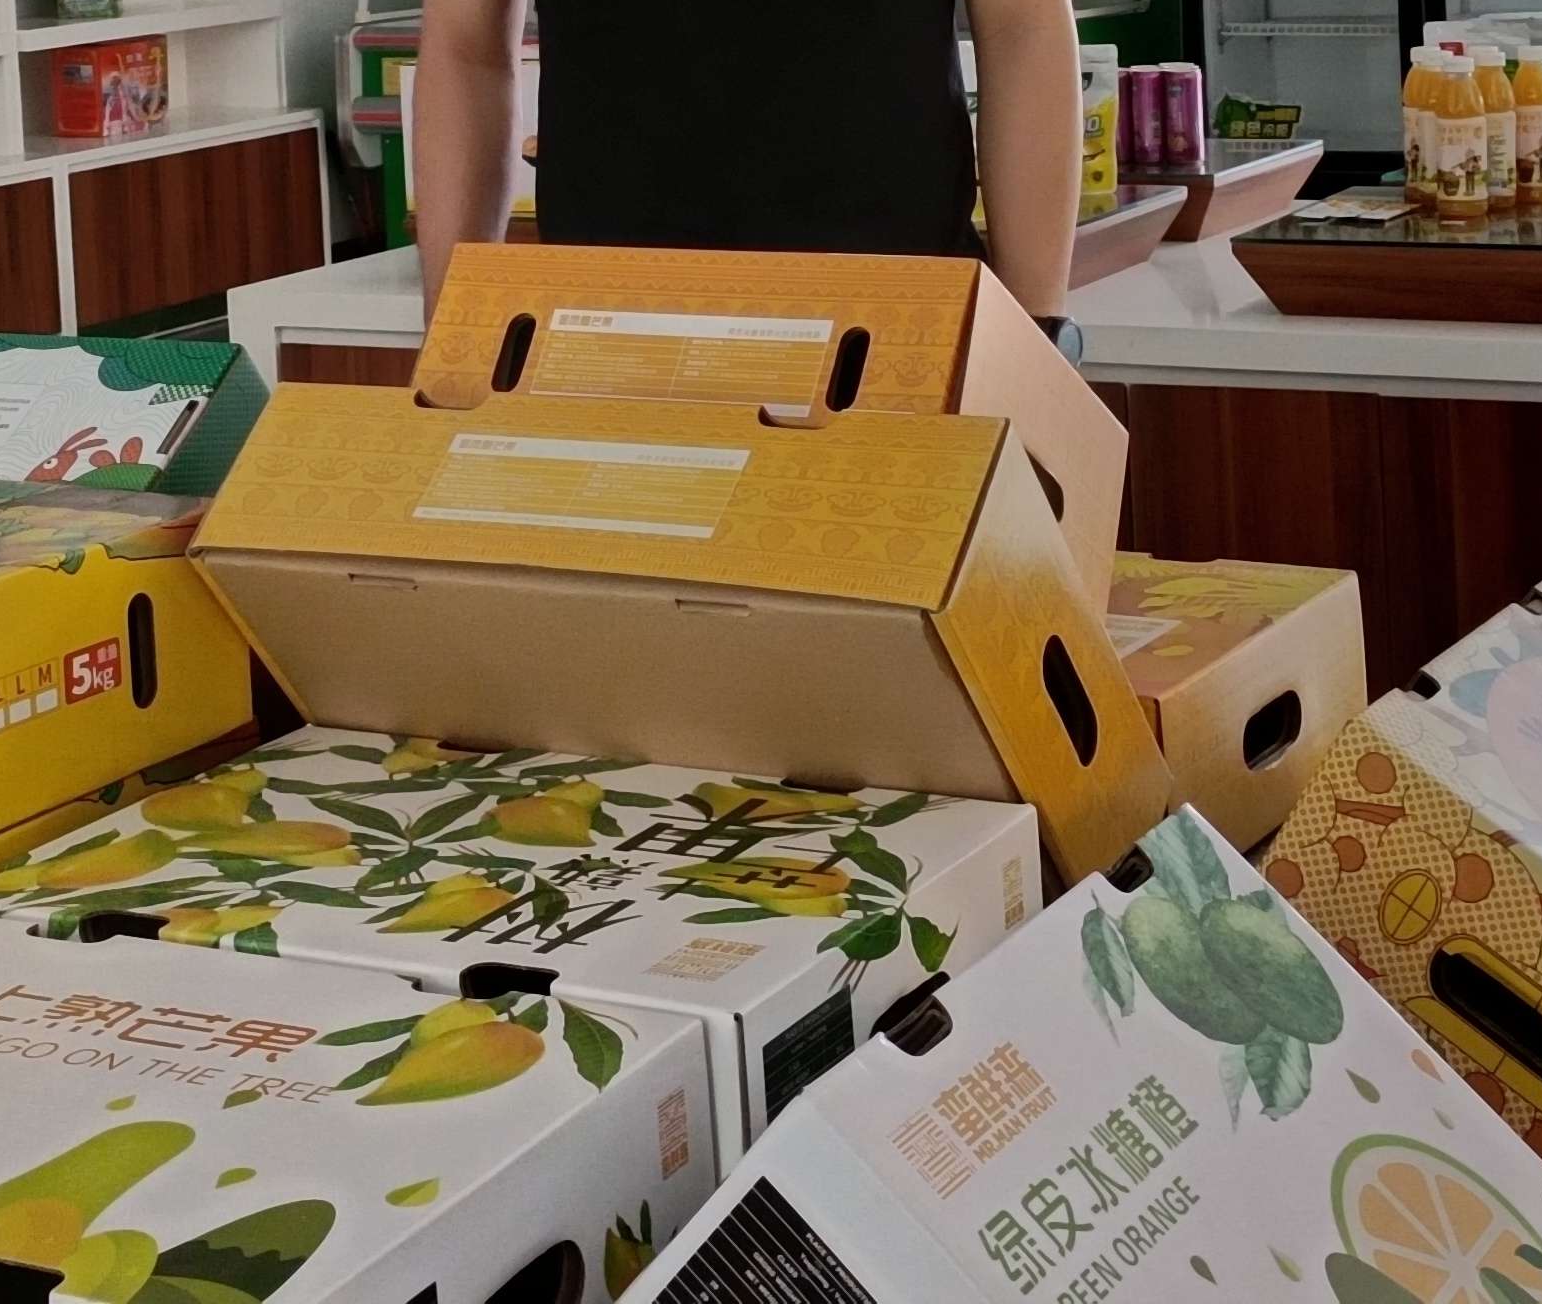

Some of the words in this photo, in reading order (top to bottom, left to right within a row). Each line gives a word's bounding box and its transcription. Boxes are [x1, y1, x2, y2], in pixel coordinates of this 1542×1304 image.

[15, 674, 25, 696] L
[38, 664, 53, 686] M
[71, 653, 115, 697] 5kg
[63, 1046, 135, 1072] ON
[147, 1057, 229, 1088] THE
[237, 1071, 338, 1107] TREE
[1019, 1085, 1058, 1124] FRUIT
[977, 1073, 1200, 1297] 绿皮冰糖橙
[1112, 1175, 1201, 1267] ORANGE
